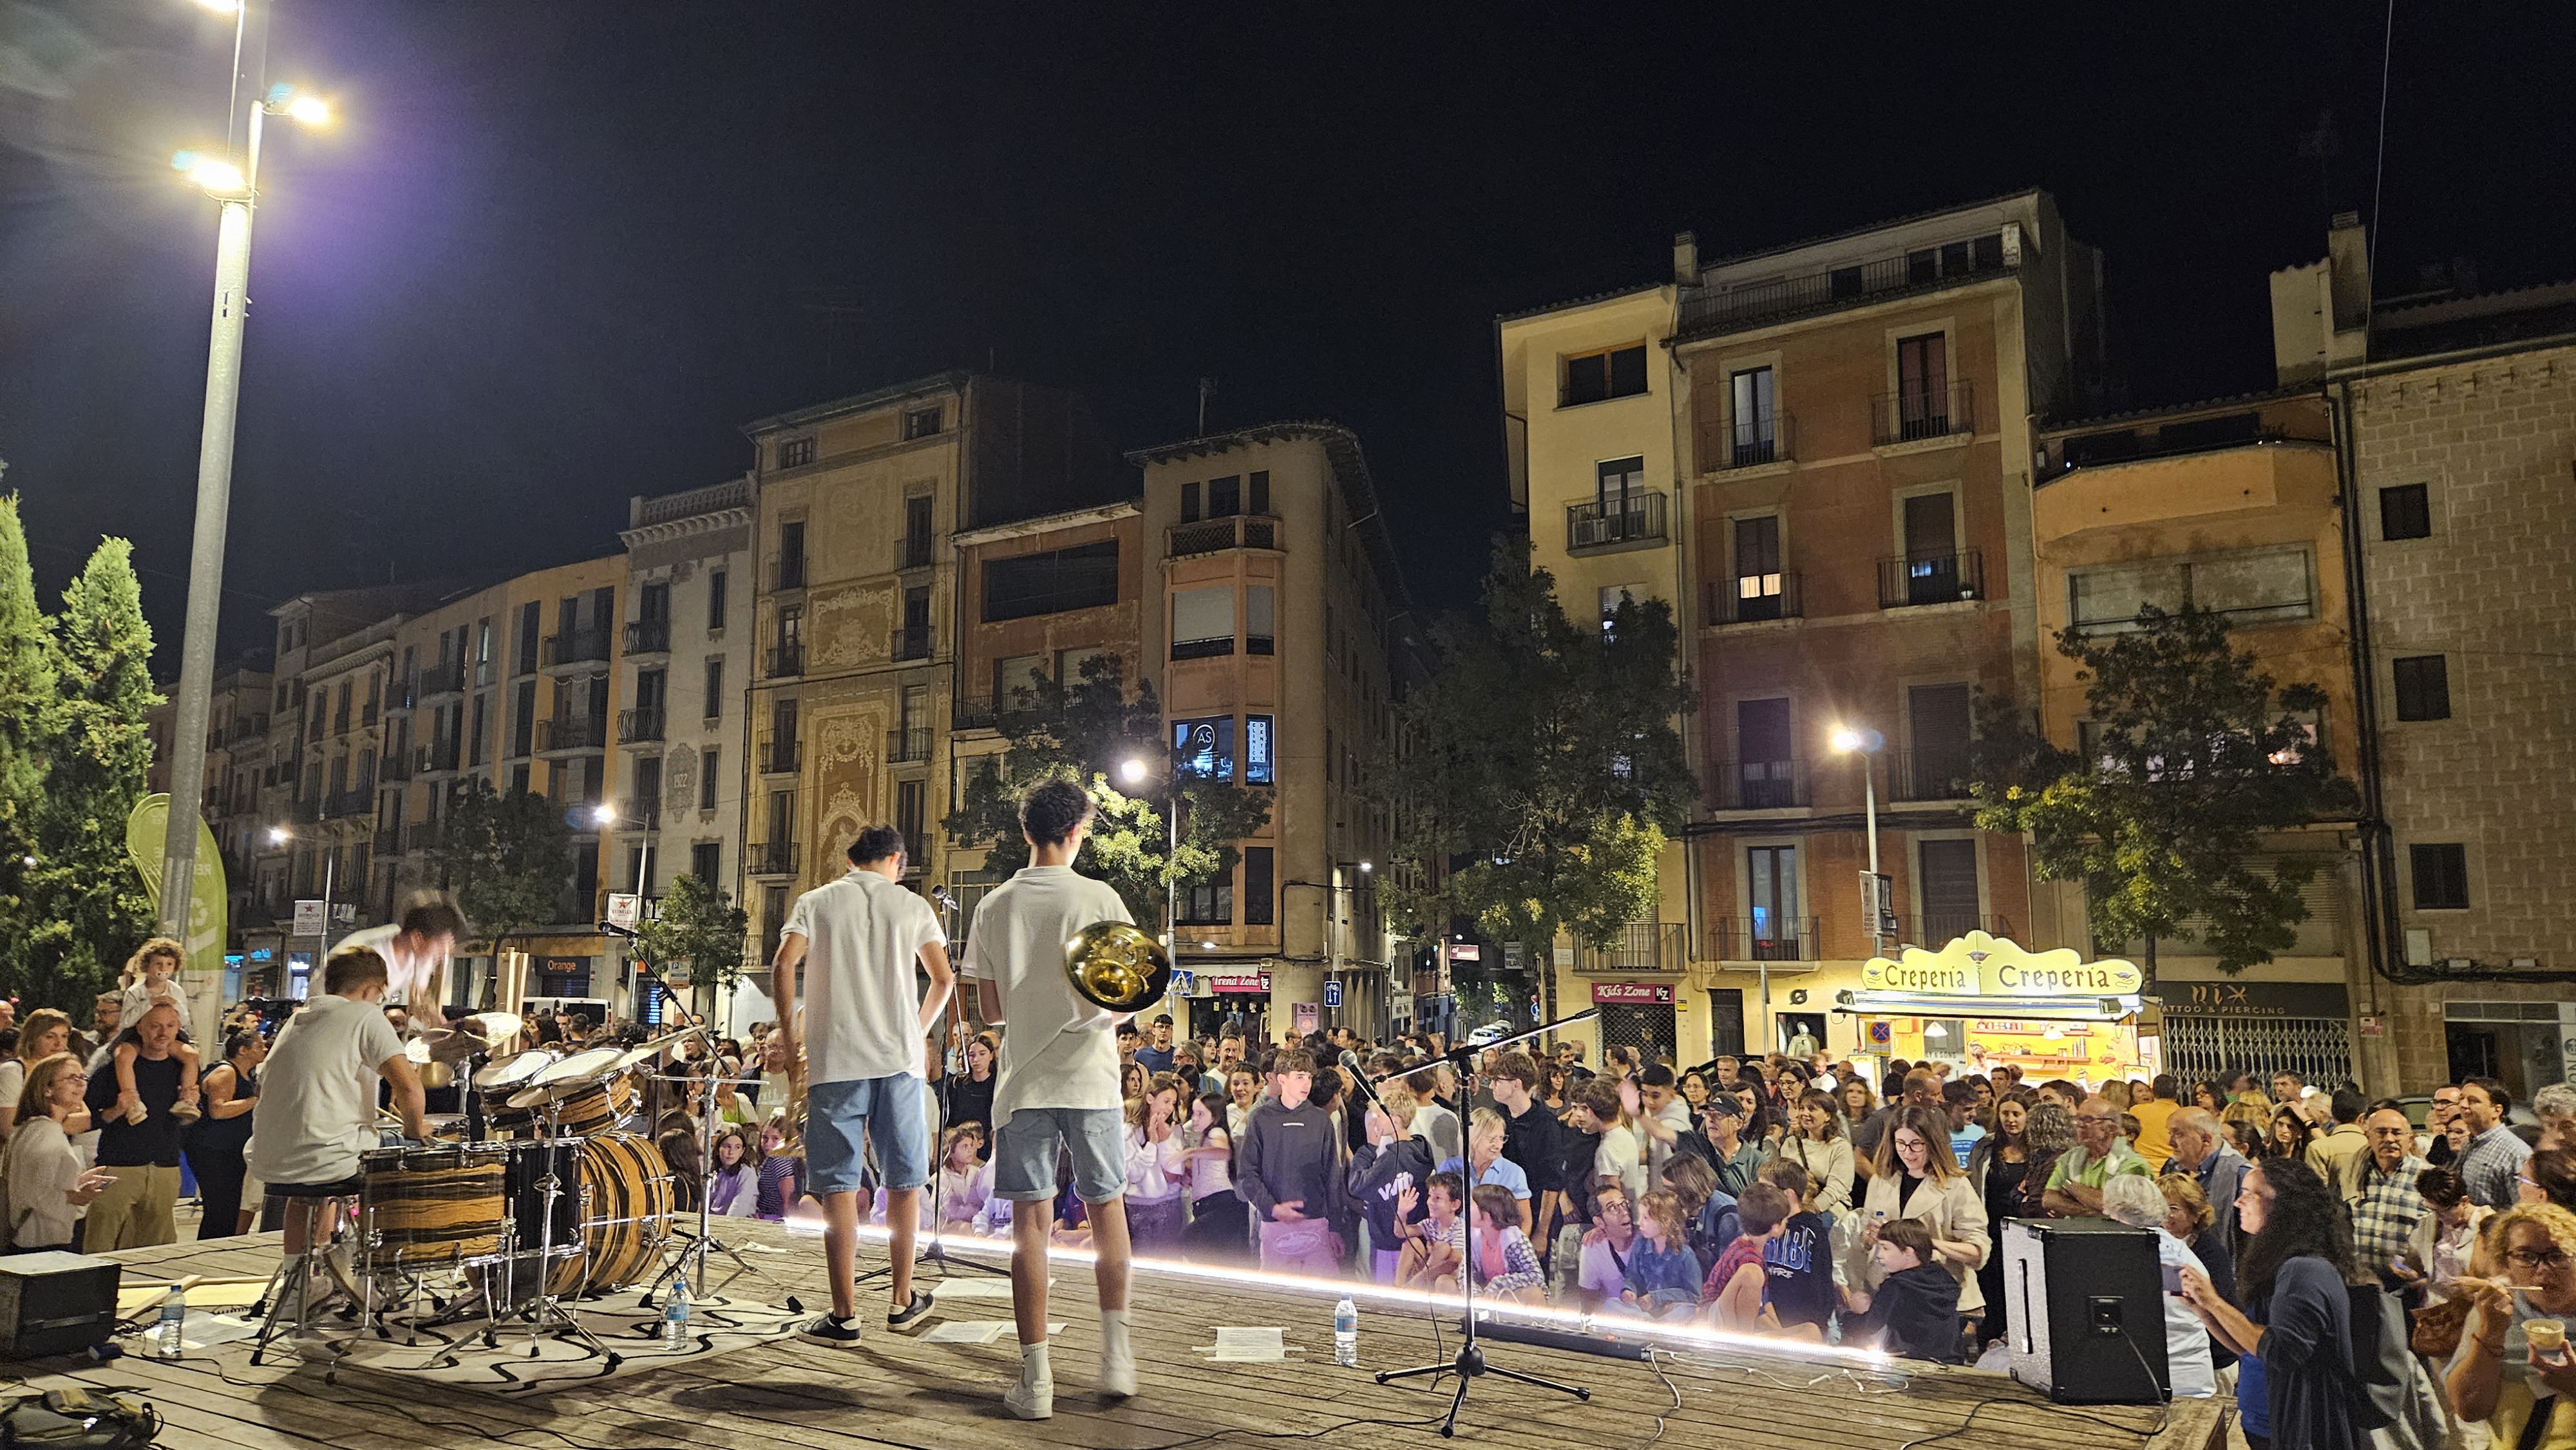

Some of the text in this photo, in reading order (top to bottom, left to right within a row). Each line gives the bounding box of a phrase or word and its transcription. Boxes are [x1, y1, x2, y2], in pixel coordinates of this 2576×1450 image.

[1197, 731, 1212, 744] AS
[547, 959, 576, 973] Orange
[1214, 977, 1237, 986] Trend
[1240, 977, 1260, 986] Zone
[1597, 984, 1669, 1001] Kids Zone KZ
[2221, 1006, 2285, 1015] PIERCING
